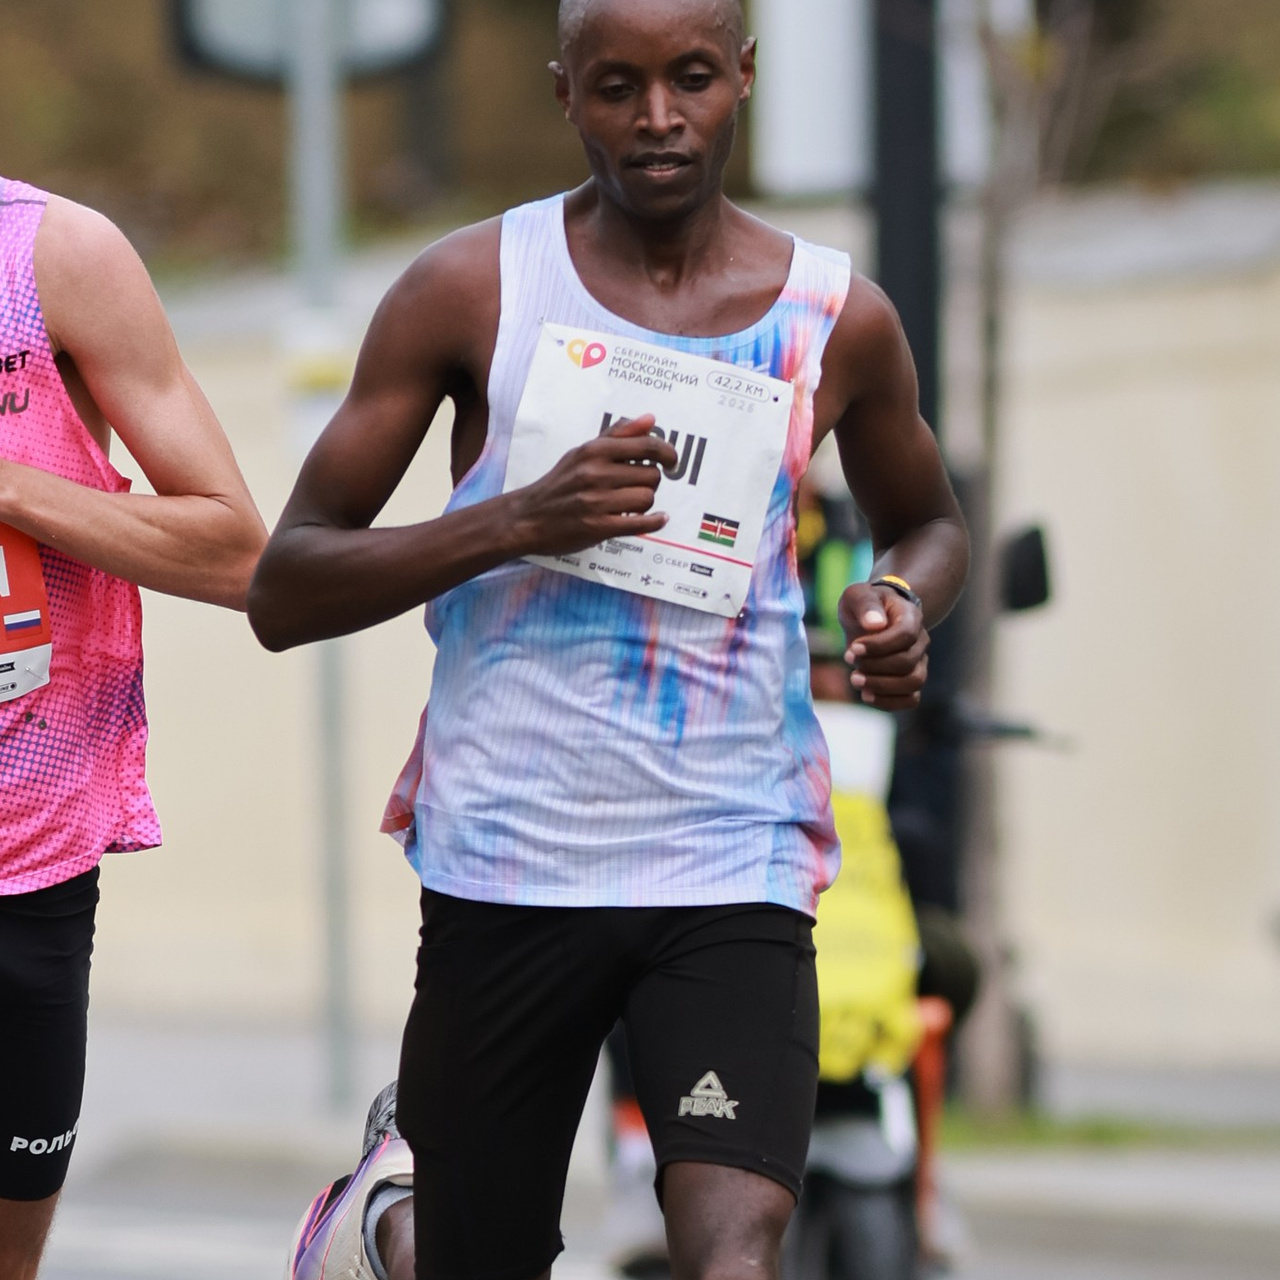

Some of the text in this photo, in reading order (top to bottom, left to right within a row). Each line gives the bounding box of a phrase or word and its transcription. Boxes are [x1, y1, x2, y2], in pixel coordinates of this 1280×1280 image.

[614, 346, 678, 369] СБЕРПРАЙМ
[608, 367, 673, 393] МАРАФОН
[611, 356, 698, 386] МОСКОВСКИЙ
[715, 376, 742, 391] 42,2
[678, 1096, 739, 1120] PEAK
